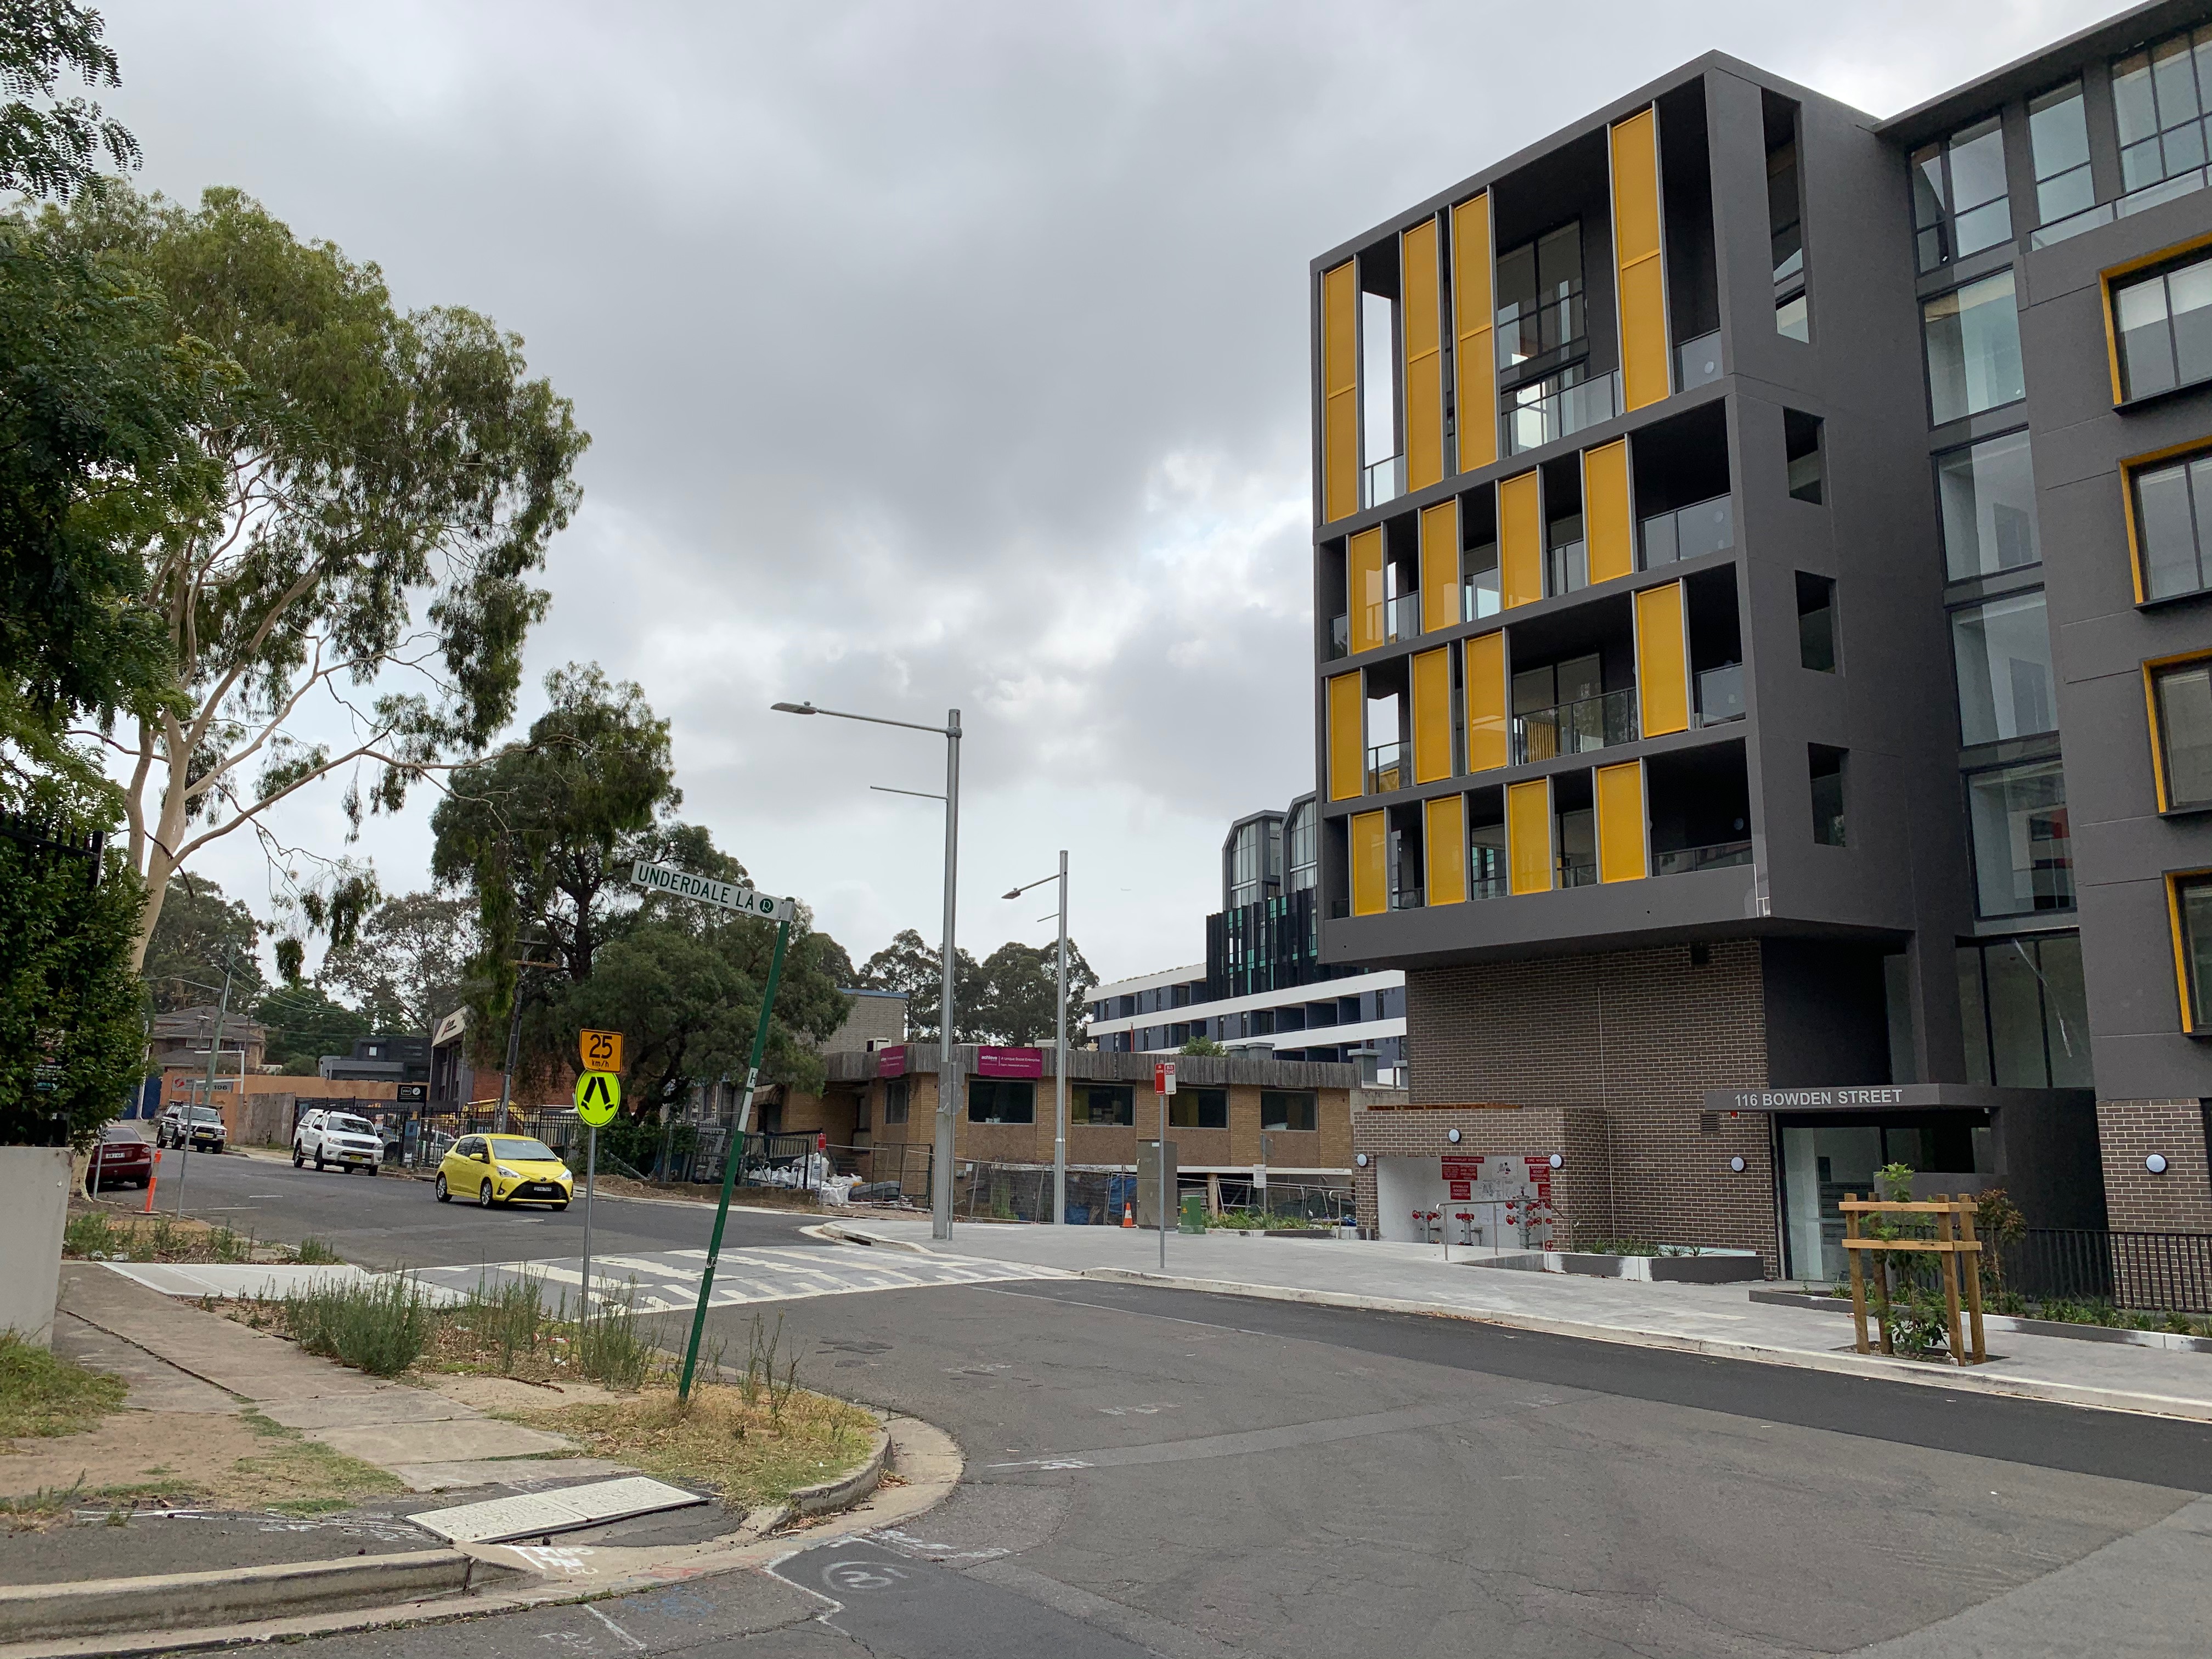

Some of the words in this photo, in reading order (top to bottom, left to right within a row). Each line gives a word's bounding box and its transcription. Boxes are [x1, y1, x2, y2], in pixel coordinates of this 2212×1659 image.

[638, 865, 730, 904] UNDERDALE
[736, 891, 753, 911] LA
[589, 1034, 612, 1059] 25
[1735, 1093, 1758, 1107] 116
[1762, 1091, 1831, 1107] BOWDEN
[1838, 1089, 1903, 1104] STREET
